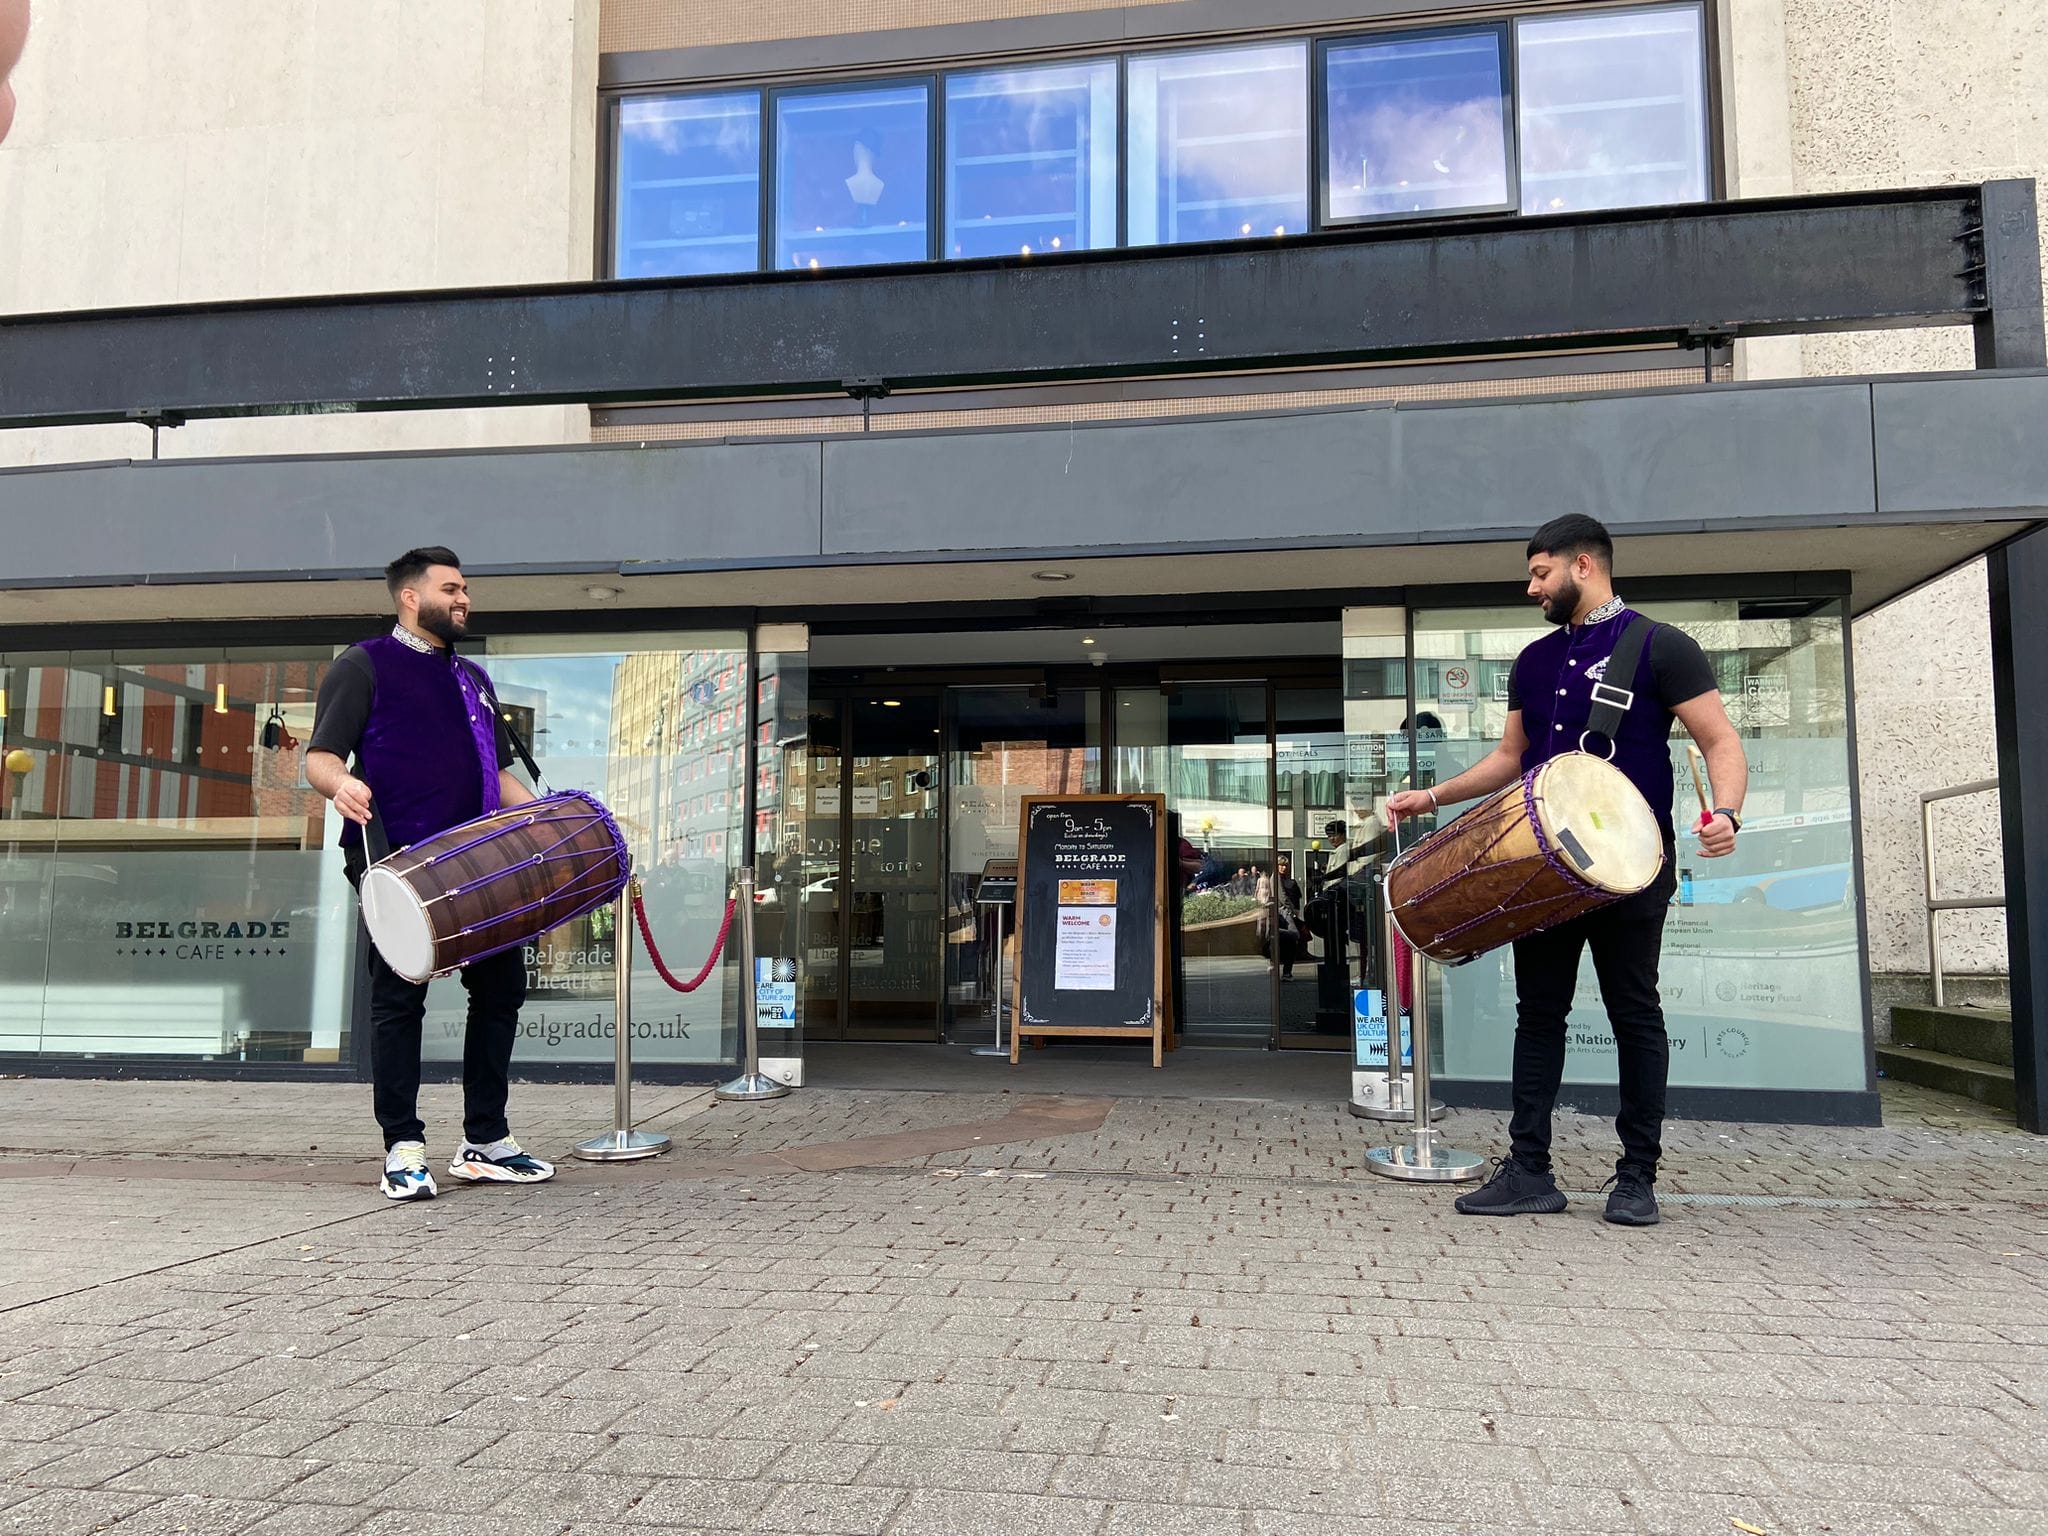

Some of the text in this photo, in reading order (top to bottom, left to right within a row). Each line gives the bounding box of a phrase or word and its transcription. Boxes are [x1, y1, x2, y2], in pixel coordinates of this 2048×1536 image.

[1748, 686, 1784, 696] CCTV
[1054, 854, 1126, 862] BELGRADE
[115, 921, 291, 939] BELGRADE
[175, 944, 225, 960] CAFE
[1671, 942, 1701, 950] Regional
[523, 944, 612, 971] Belgrade
[525, 968, 601, 990] Theatre
[1740, 993, 1775, 1003] Lottery
[1583, 1023, 1591, 1031] by
[1716, 1027, 1751, 1047] ARTS COUNCIL
